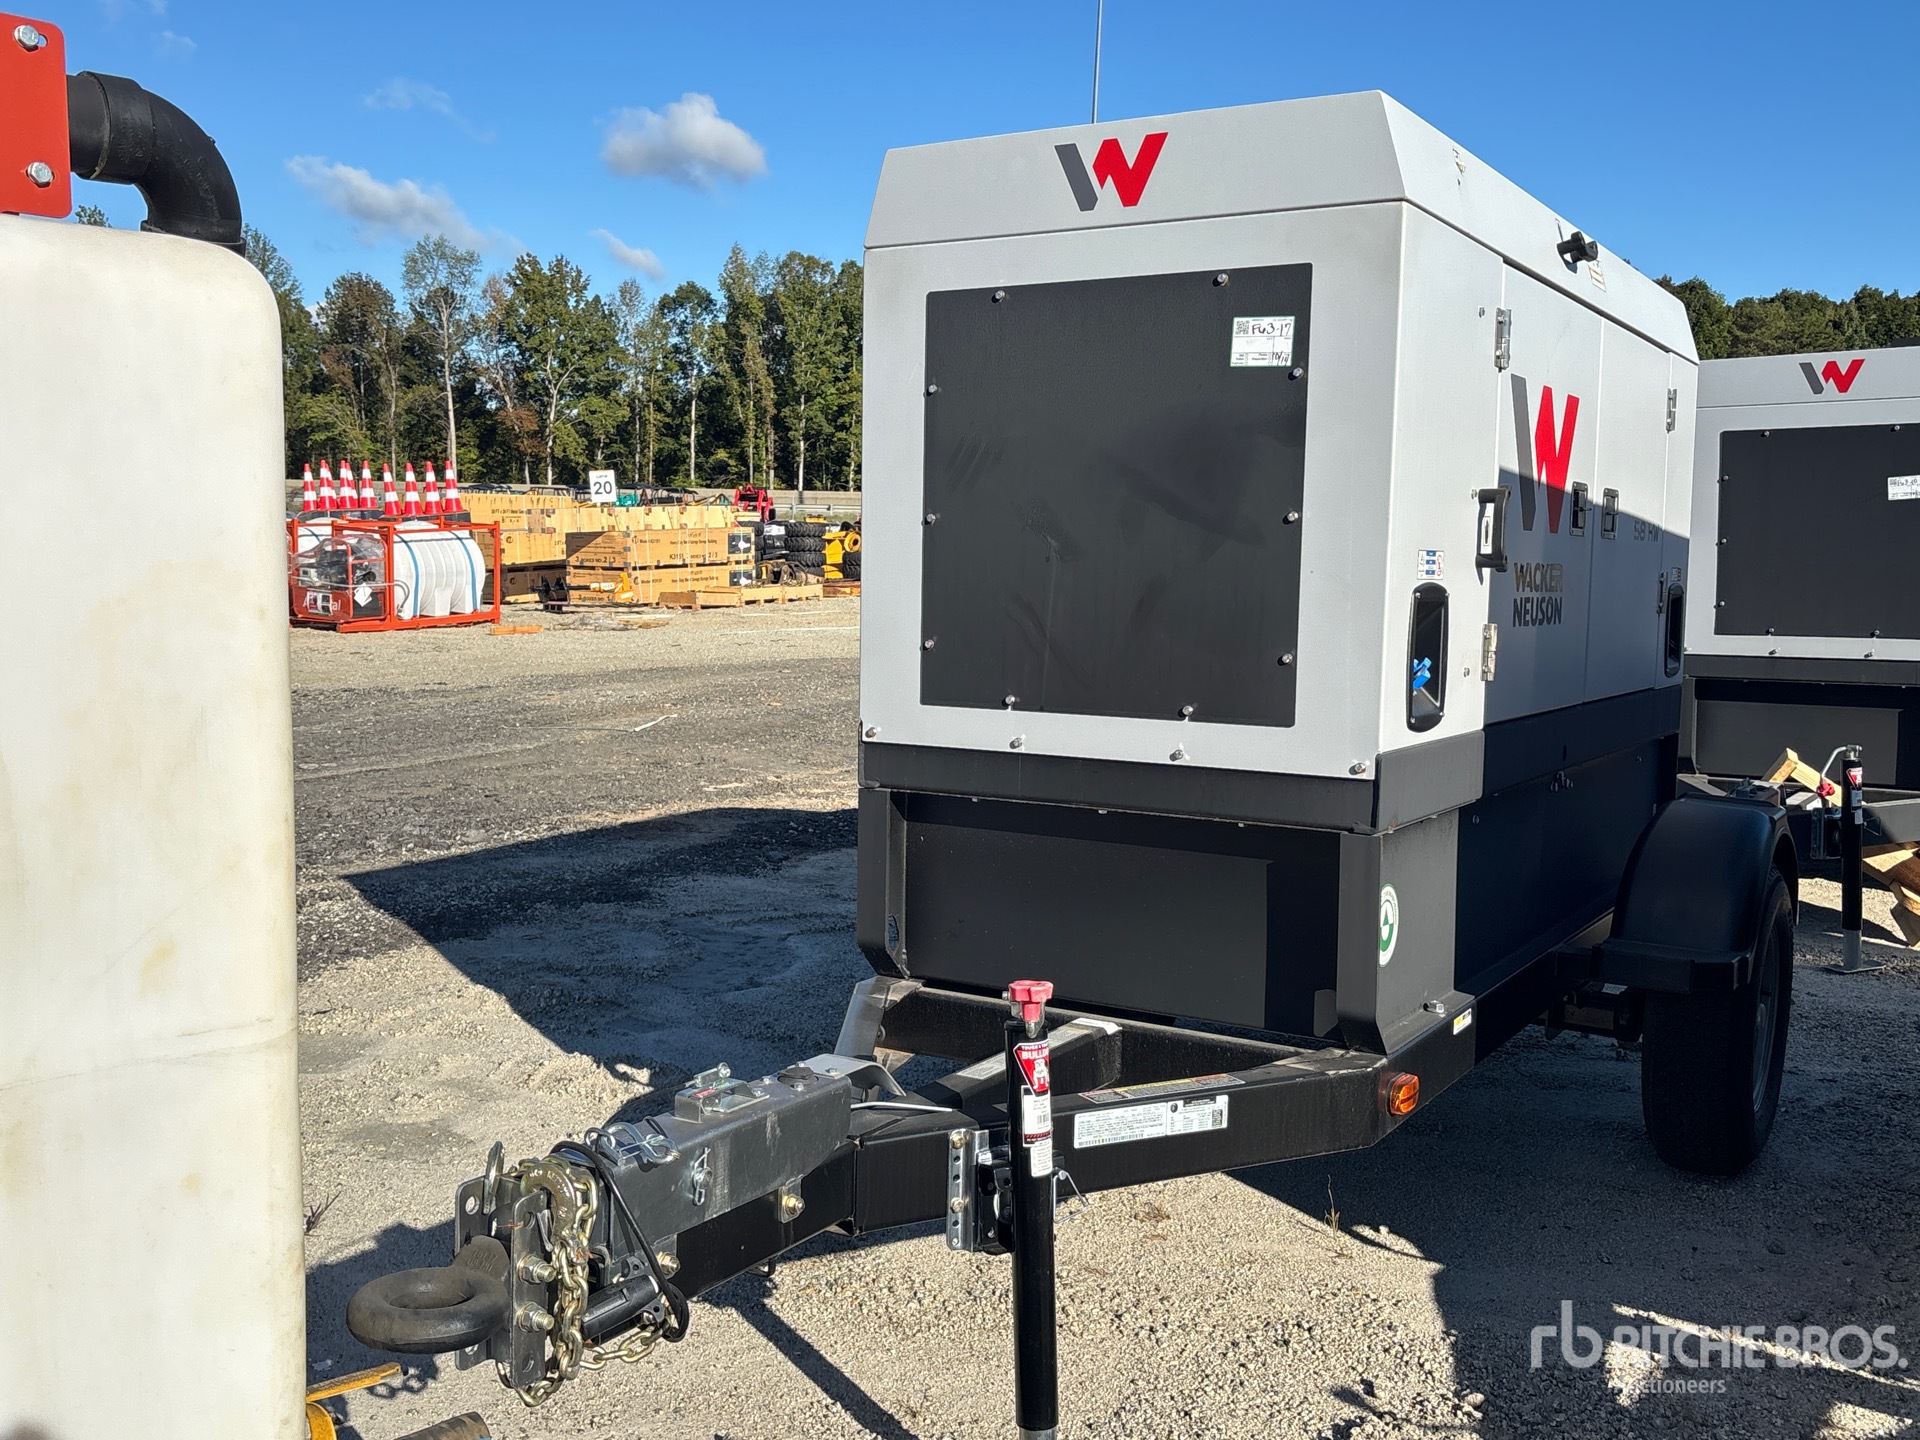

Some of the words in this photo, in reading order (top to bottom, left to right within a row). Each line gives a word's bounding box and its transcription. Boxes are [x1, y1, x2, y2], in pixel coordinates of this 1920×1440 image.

[593, 481, 613, 495] 20
[1513, 562, 1564, 592] WACKER
[1512, 596, 1563, 627] NEUSON
